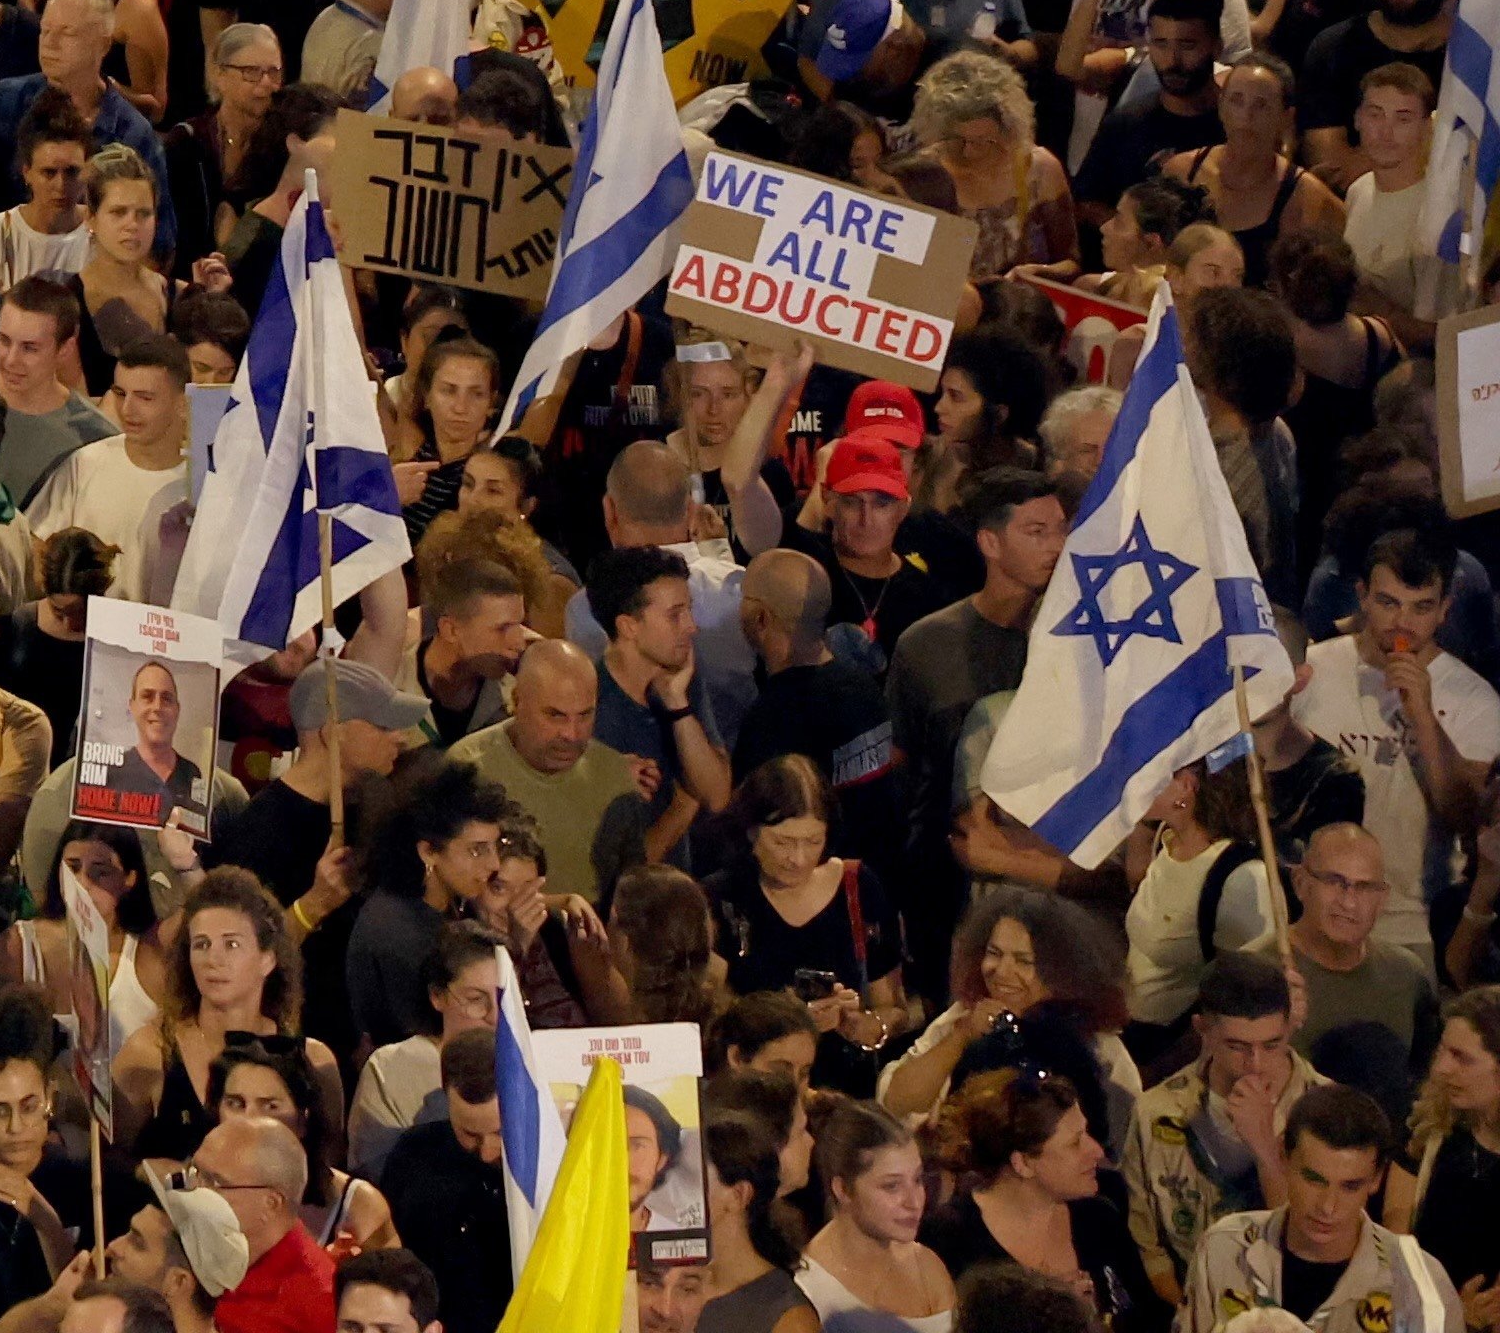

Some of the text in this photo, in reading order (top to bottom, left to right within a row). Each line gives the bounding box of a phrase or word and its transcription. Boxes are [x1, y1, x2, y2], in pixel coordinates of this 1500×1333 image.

[689, 49, 749, 86] NOW
[373, 130, 574, 214] אין דבר
[362, 175, 560, 283] יותר חשוב
[705, 158, 904, 254] WE ARE
[766, 230, 853, 290] ALL
[671, 252, 945, 365] ABDUCTED
[80, 762, 108, 787] HIM
[82, 740, 124, 768] BRING
[78, 786, 161, 815] HOME NOW!
[634, 1051, 650, 1065] TOV
